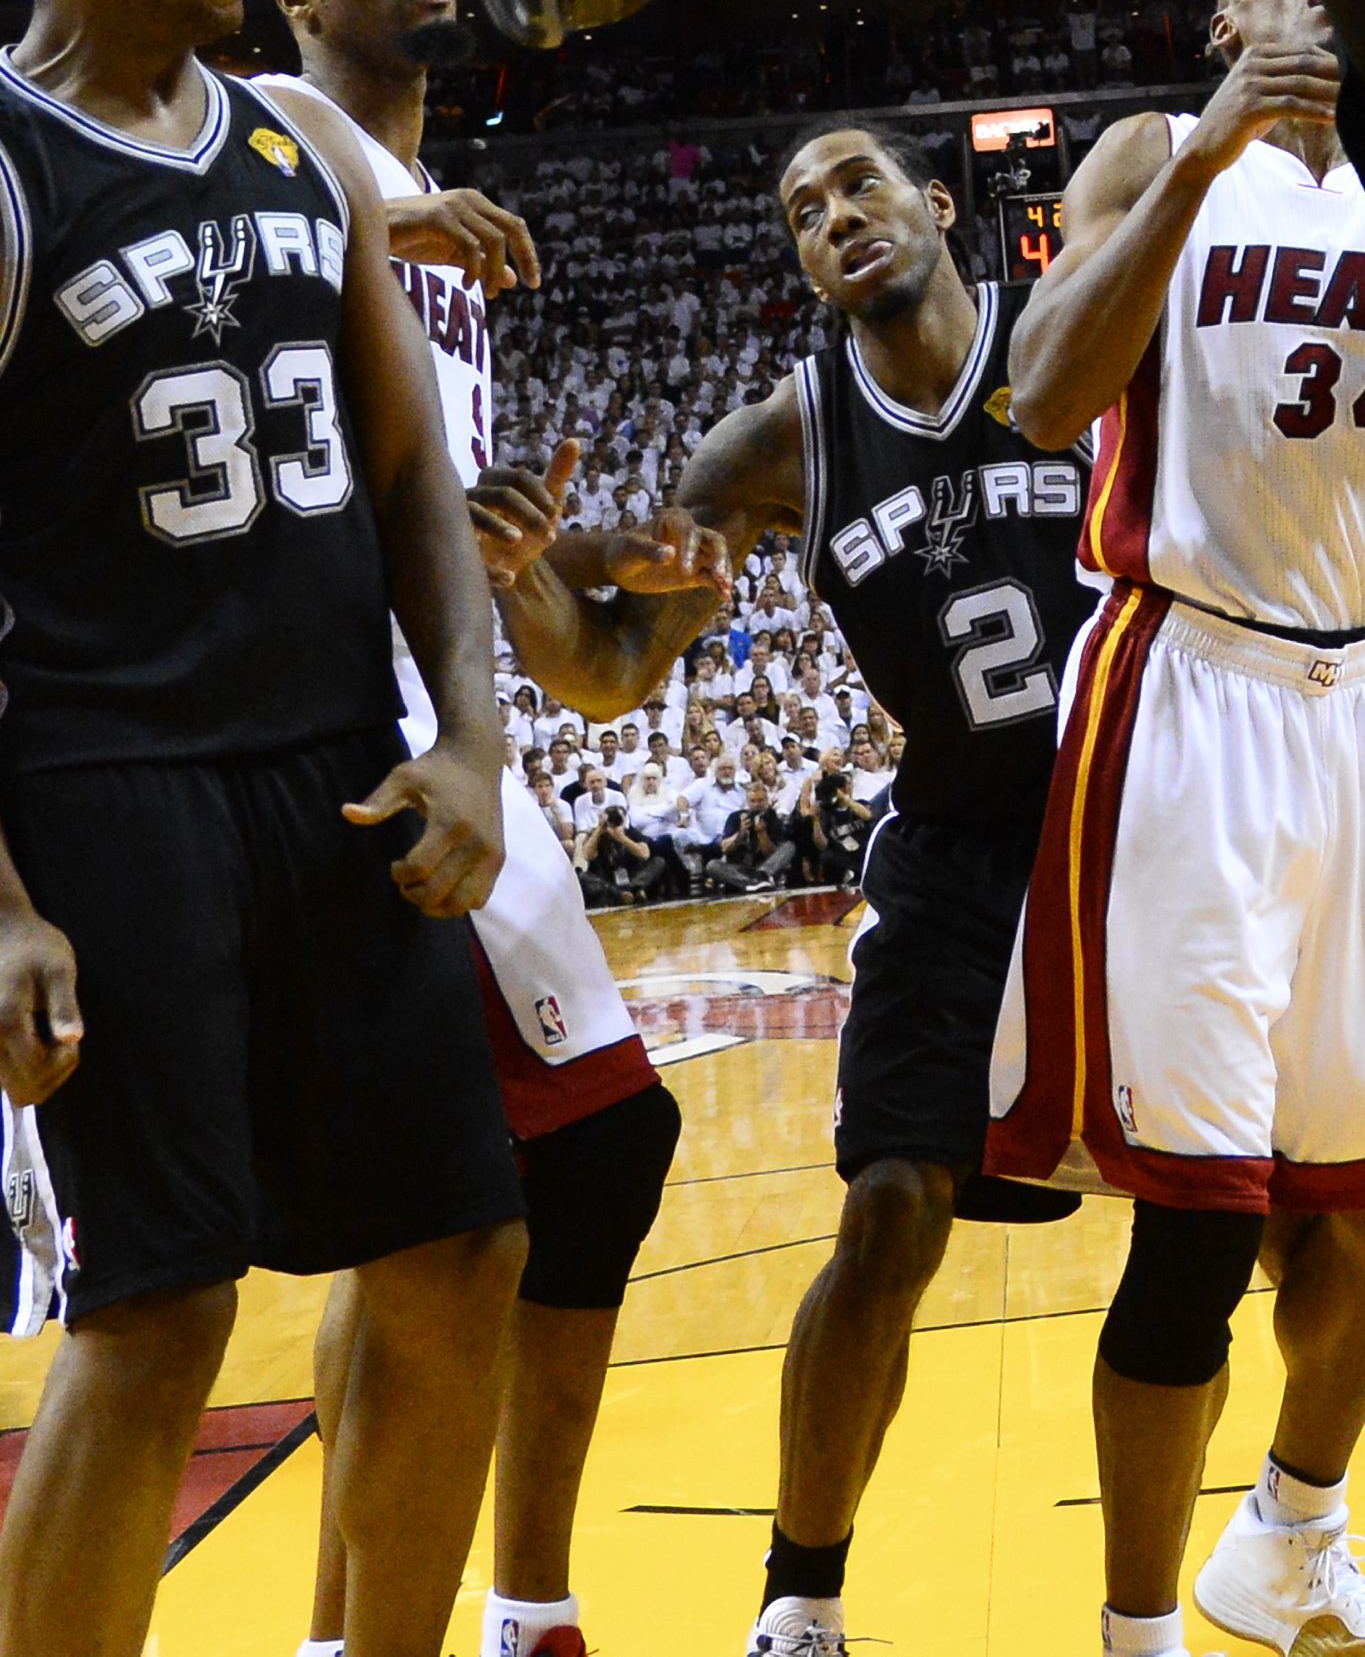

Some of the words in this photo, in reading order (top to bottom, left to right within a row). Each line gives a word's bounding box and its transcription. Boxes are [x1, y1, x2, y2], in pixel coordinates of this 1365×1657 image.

[54, 211, 348, 347] SPURS
[130, 340, 354, 547] 33
[829, 460, 1082, 587] SPURS
[936, 575, 1061, 731] 2
